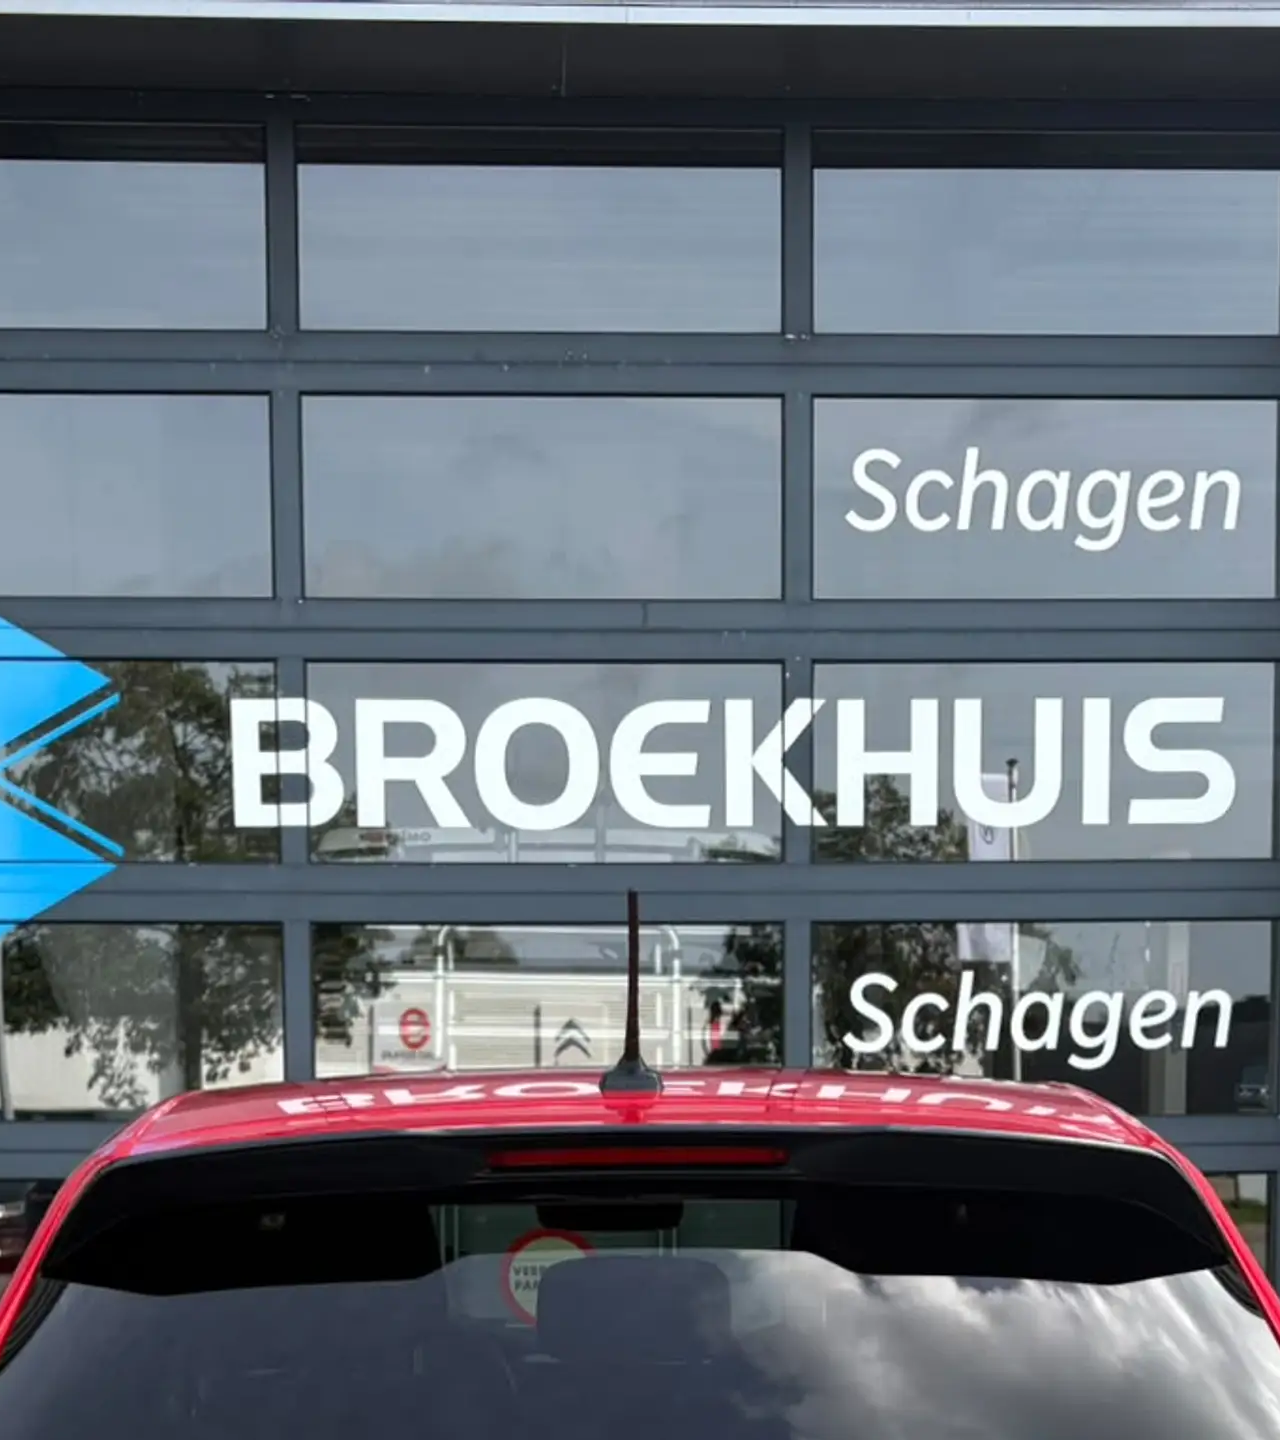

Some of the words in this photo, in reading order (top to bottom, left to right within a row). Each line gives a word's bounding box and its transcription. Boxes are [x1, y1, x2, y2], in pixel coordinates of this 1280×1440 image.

[845, 446, 1241, 552] Schagen
[231, 697, 1236, 831] BROEKHUIS
[842, 970, 1233, 1071] Schagen
